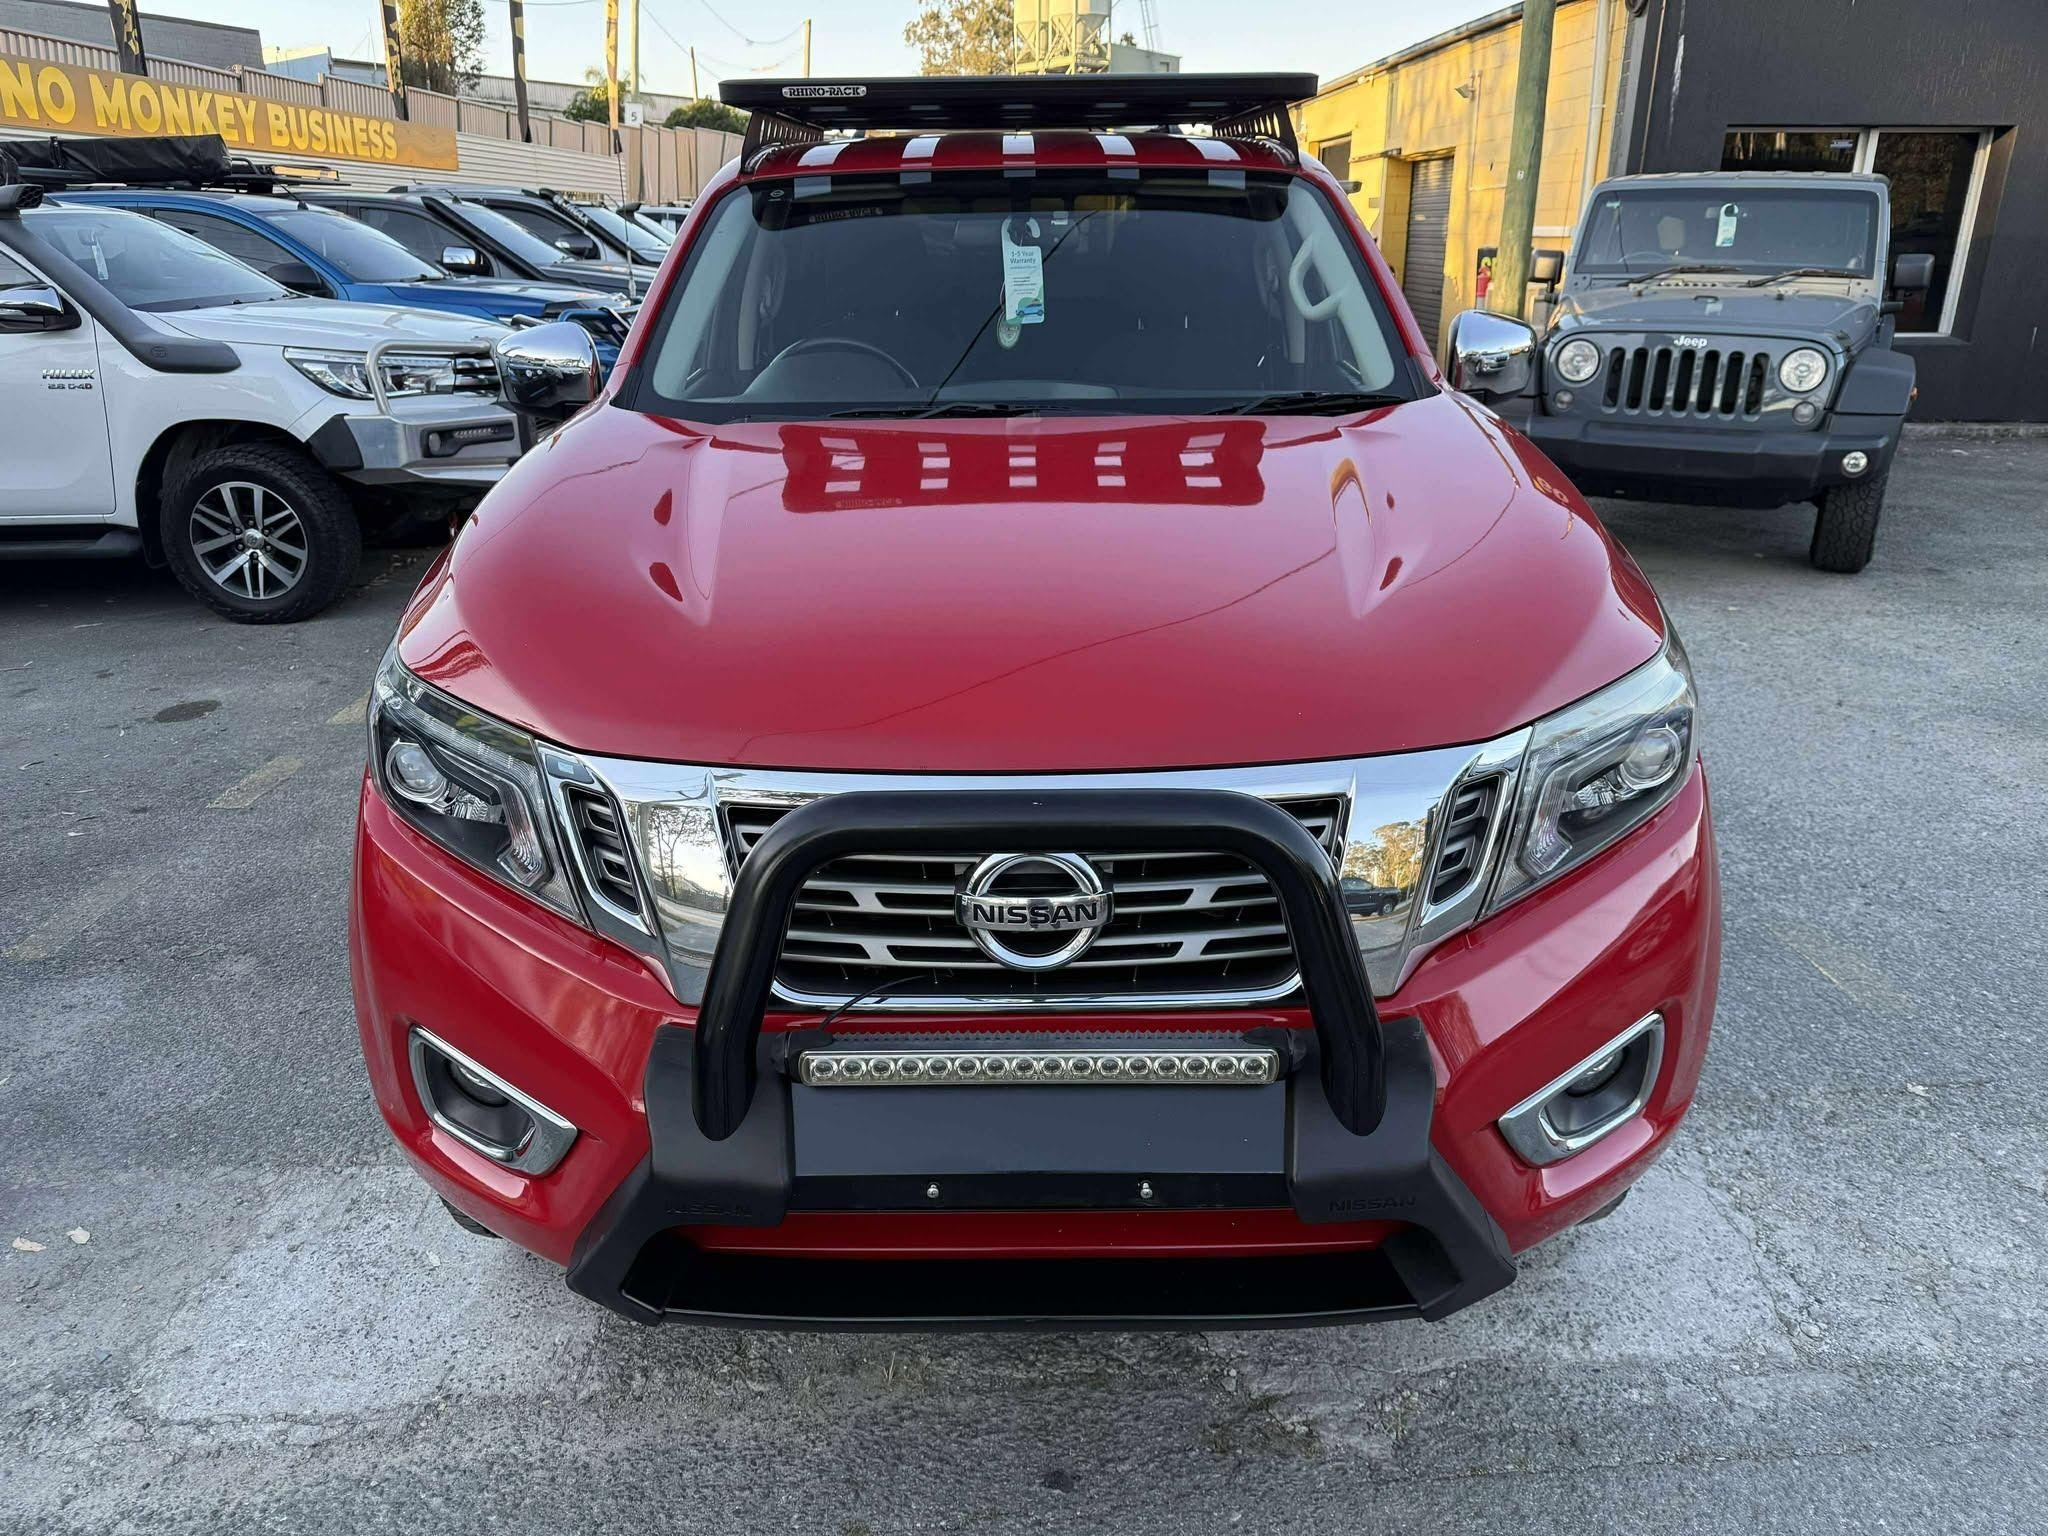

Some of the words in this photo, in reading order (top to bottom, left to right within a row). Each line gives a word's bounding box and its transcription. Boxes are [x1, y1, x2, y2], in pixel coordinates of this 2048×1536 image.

[788, 86, 860, 97] RHINO-RACK
[0, 59, 76, 125] NO
[88, 73, 257, 144] MONKEY
[266, 102, 399, 161] BUSINESS
[1673, 335, 1708, 348] Jeep
[42, 368, 95, 380] HILUX
[973, 902, 1098, 924] NISSAN
[1328, 1196, 1417, 1212] NISSAN
